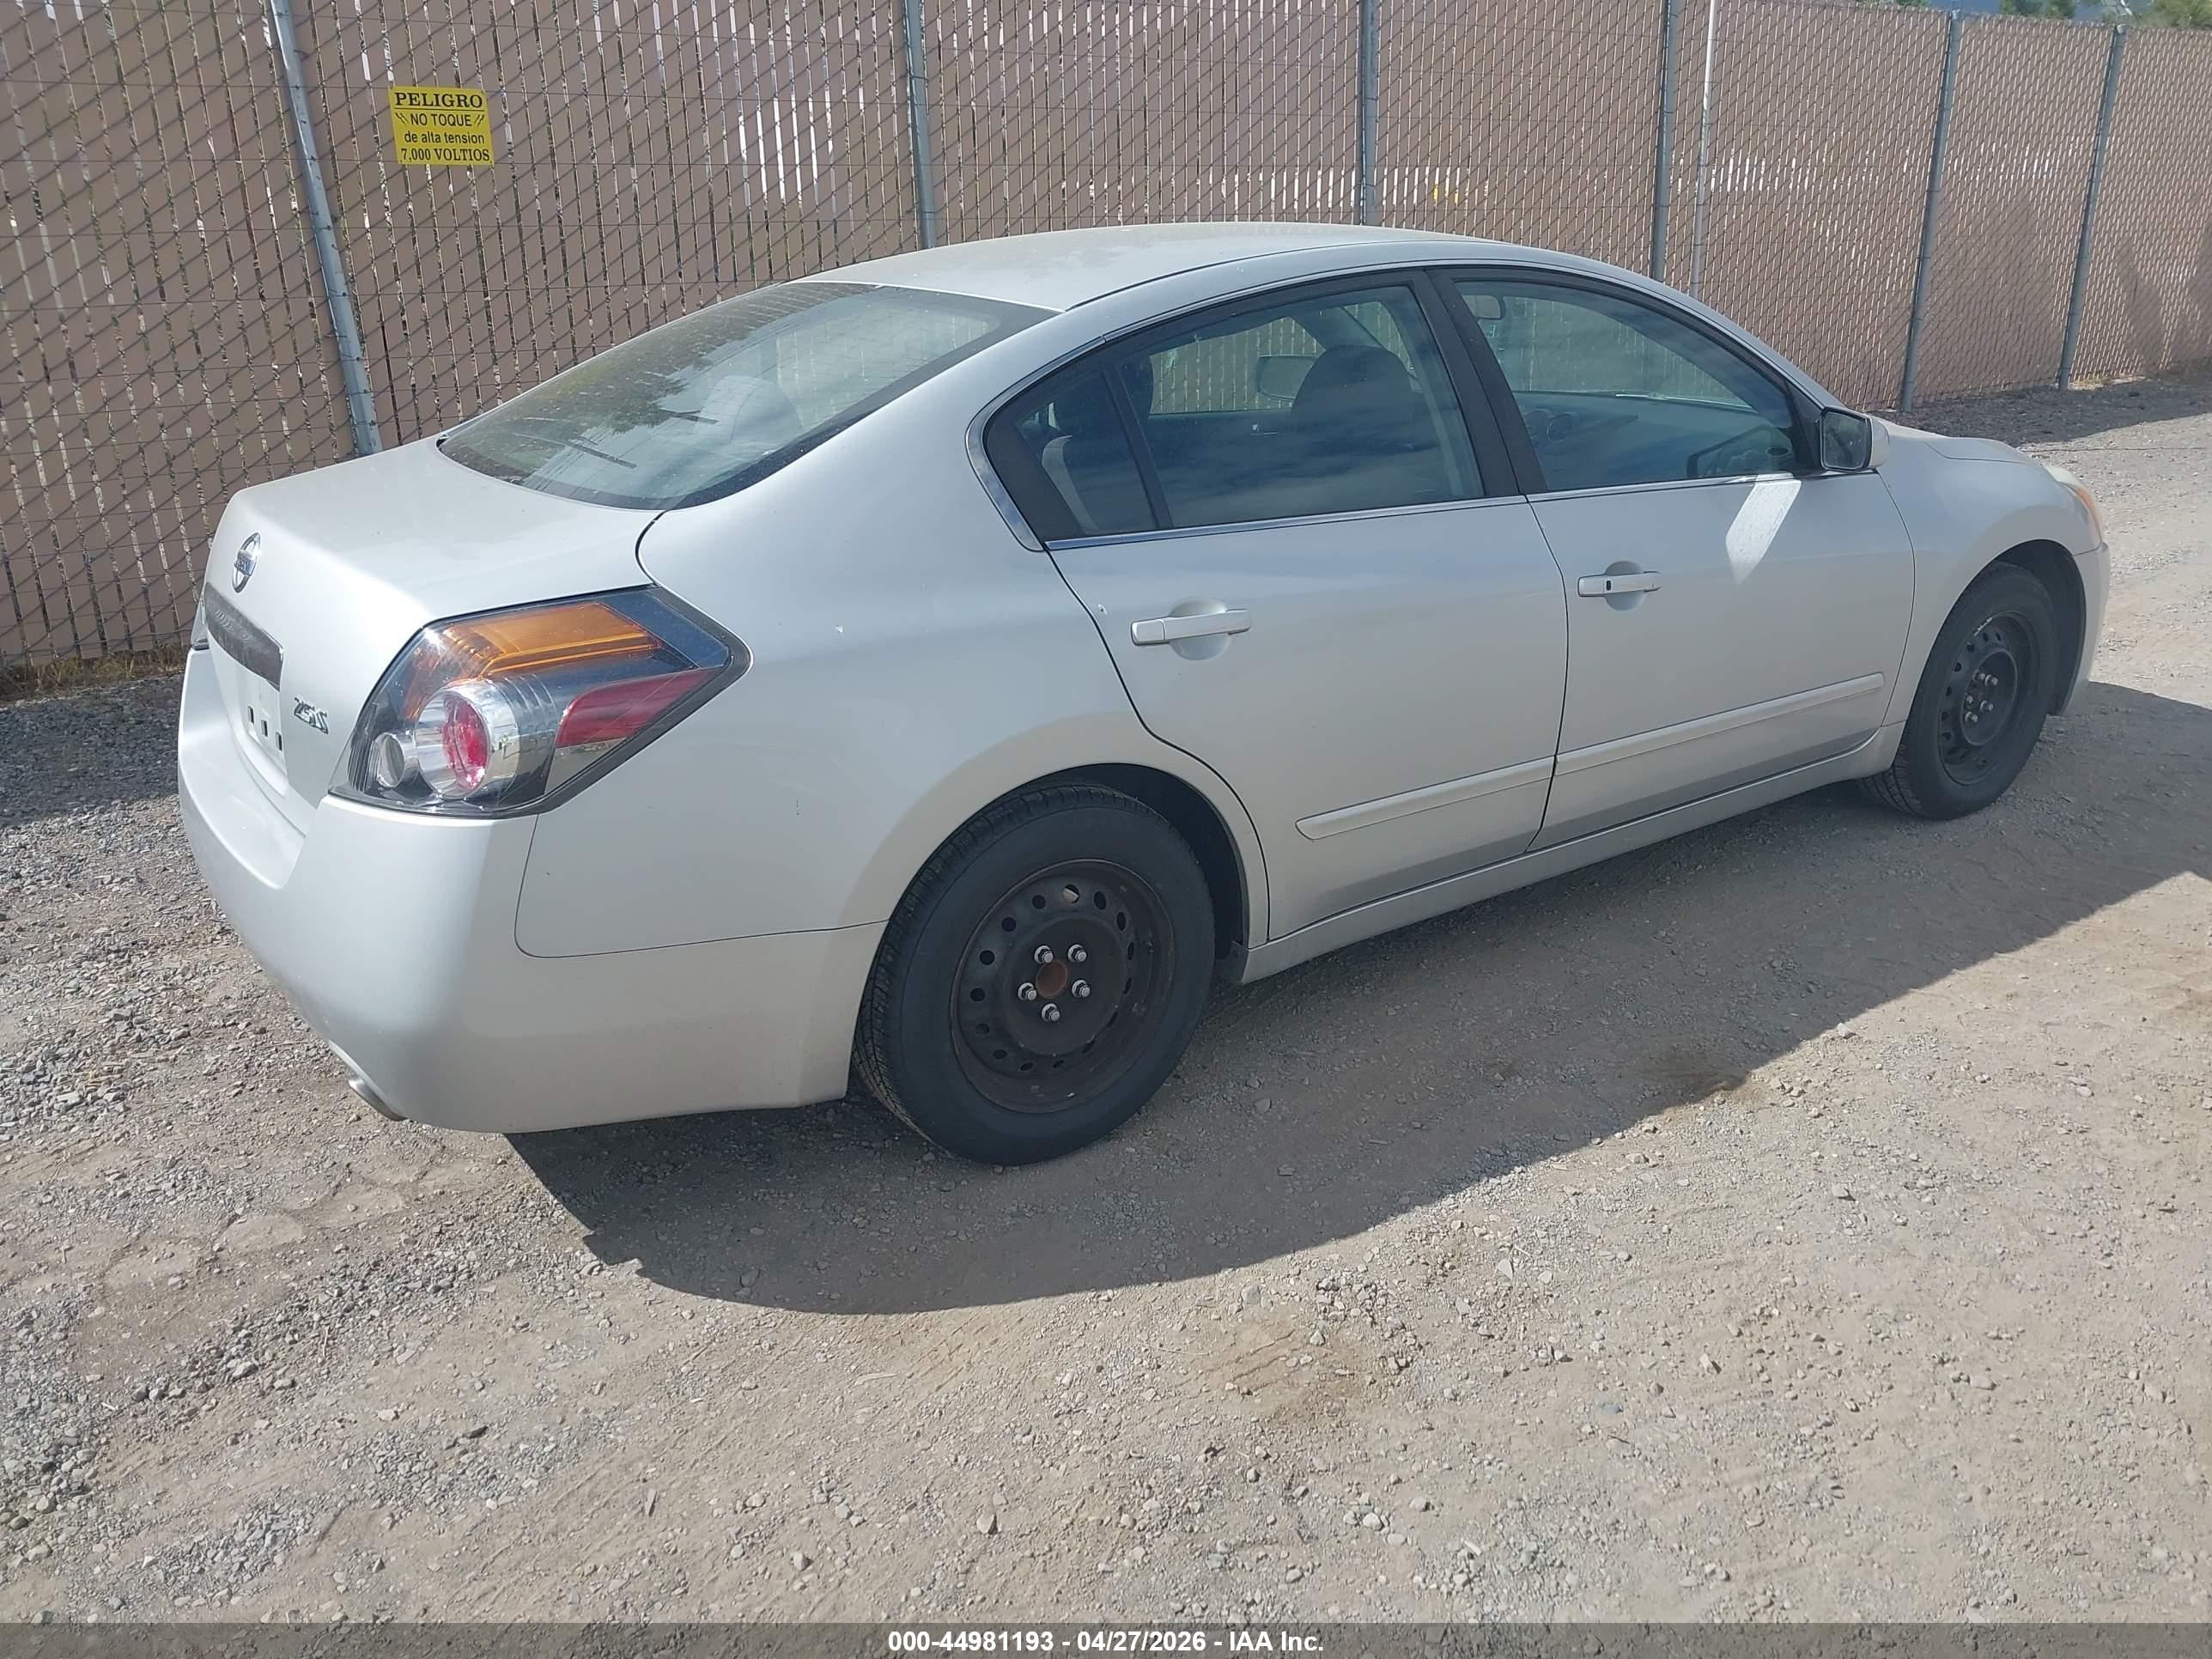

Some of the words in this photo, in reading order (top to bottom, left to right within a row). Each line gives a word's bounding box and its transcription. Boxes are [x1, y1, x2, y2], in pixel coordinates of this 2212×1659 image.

[394, 92, 483, 108] PELIGRO
[410, 113, 428, 125] NO
[431, 113, 472, 126] TOQUE
[404, 131, 418, 143] de
[422, 131, 441, 143] alta
[444, 131, 485, 144] tension
[401, 148, 431, 161] 7,000
[434, 149, 490, 161] VOLTIOS
